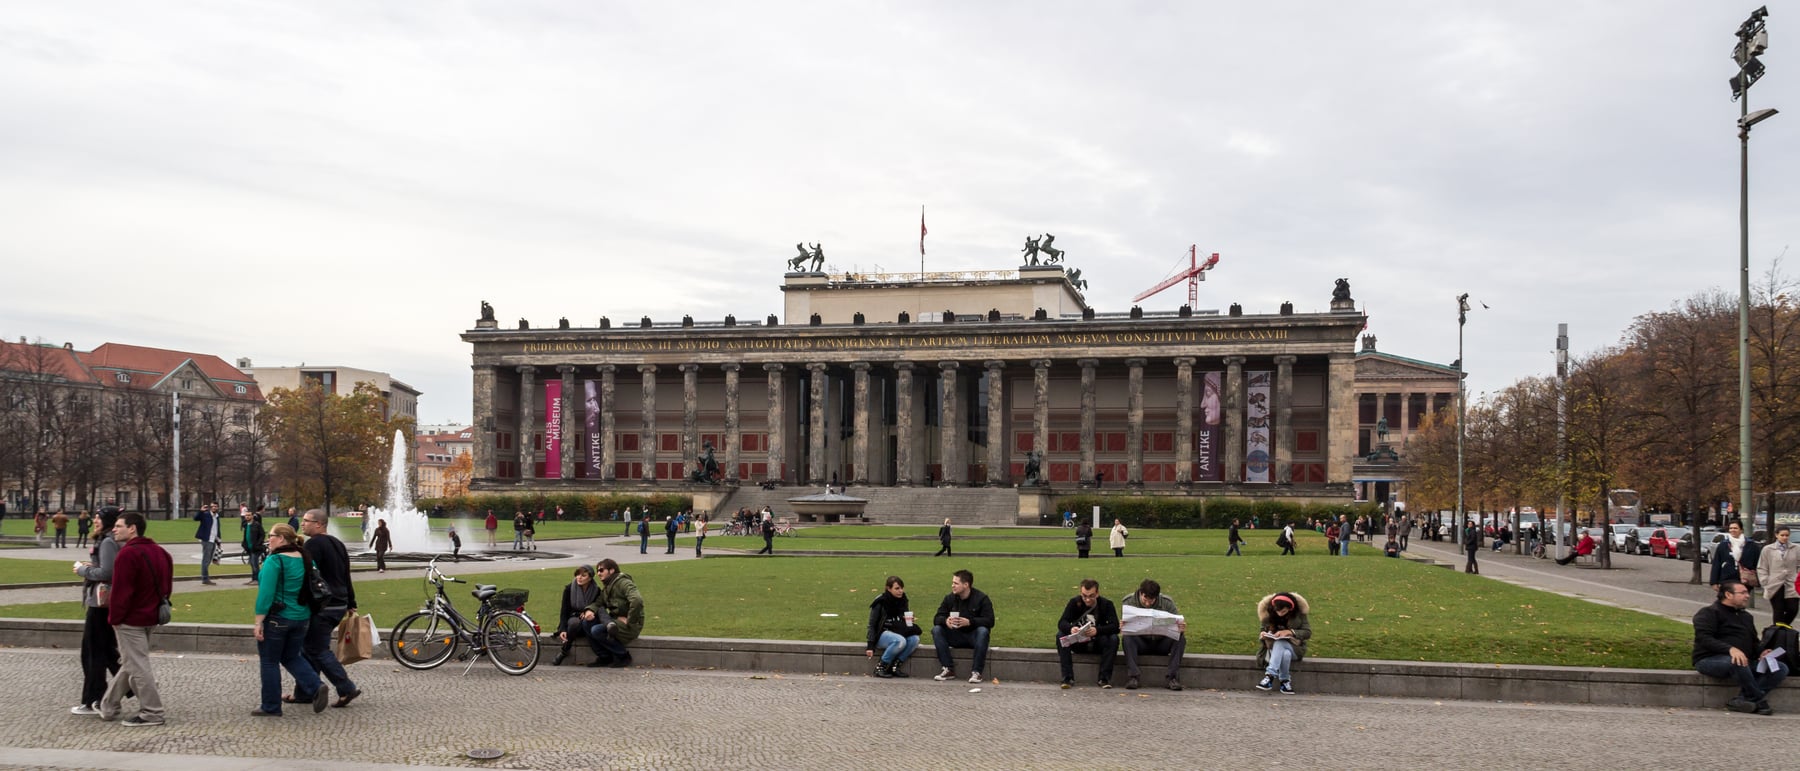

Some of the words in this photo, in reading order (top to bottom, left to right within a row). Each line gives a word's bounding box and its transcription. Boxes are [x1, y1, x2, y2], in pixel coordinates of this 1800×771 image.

[659, 340, 671, 350] III
[900, 336, 914, 347] ET
[919, 335, 968, 346] ARTIVM
[1056, 334, 1110, 344] MVSEVM
[1115, 331, 1197, 343] CONSTITVIT
[552, 397, 561, 440] MUSEUM
[592, 432, 600, 469] ANTIKE
[1200, 430, 1210, 471] ANTIKE
